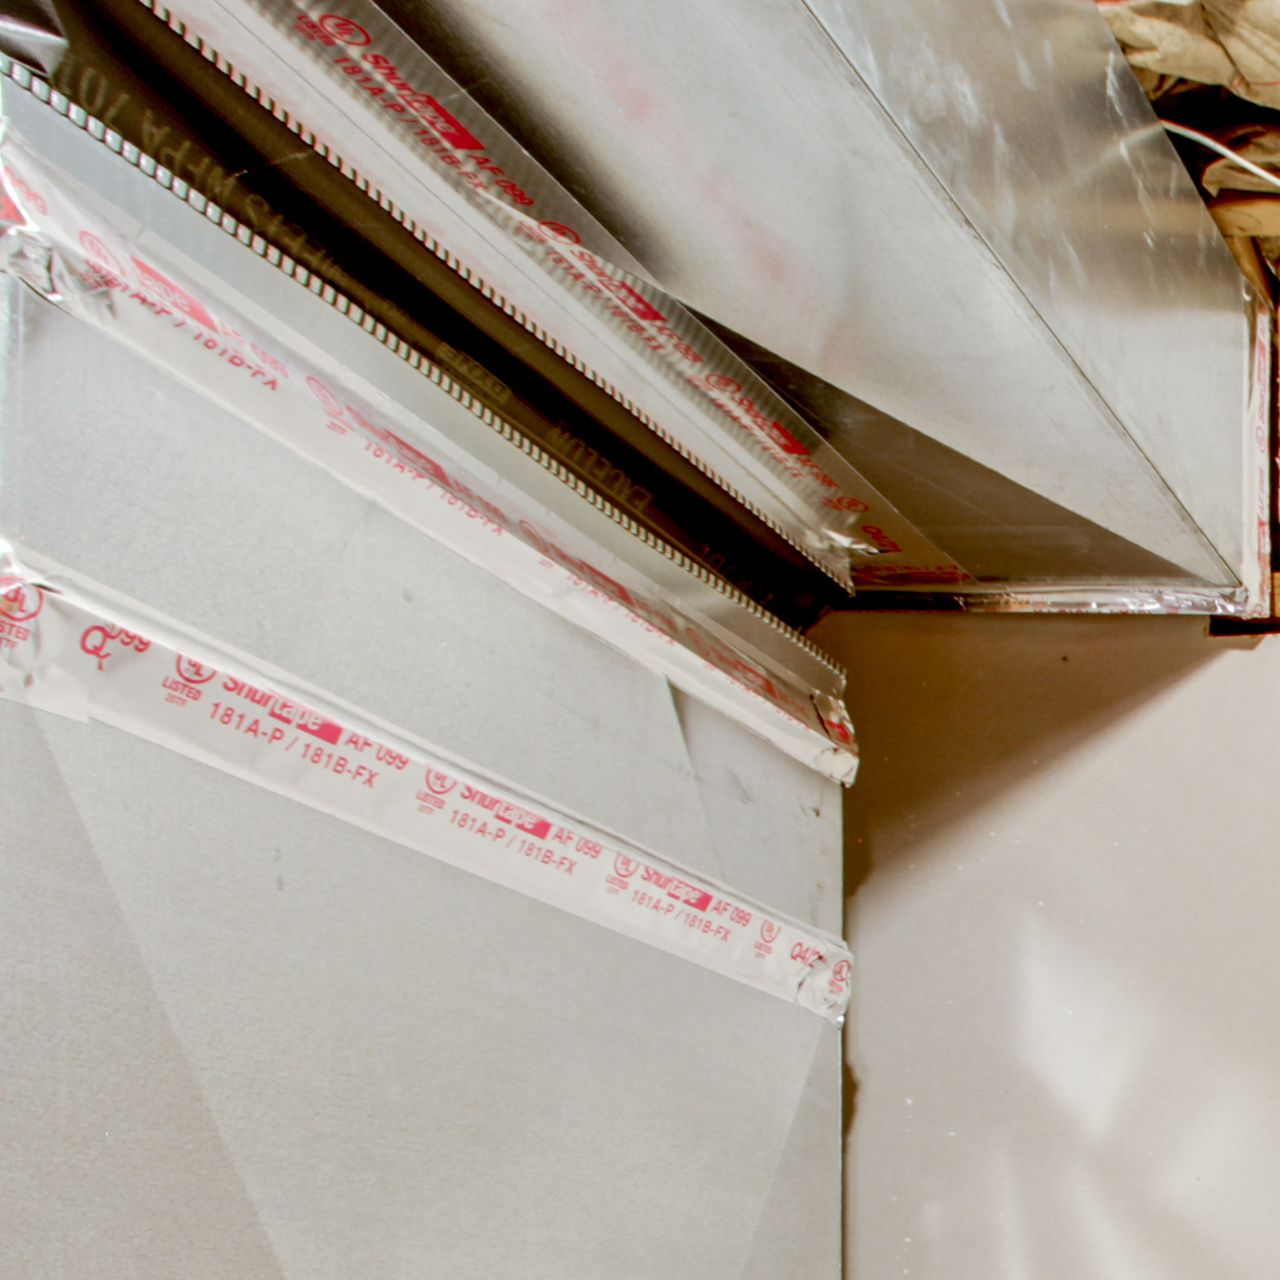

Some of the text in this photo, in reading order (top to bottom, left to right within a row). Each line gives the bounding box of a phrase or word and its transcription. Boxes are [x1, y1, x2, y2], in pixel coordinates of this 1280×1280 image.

[161, 675, 204, 702] LISTED
[209, 701, 286, 745] 181A-P
[300, 742, 380, 789] 181B-FX
[449, 808, 507, 844] 181A-P
[517, 839, 579, 876] 181B-FX
[630, 888, 676, 916] 181A-P
[683, 911, 733, 943] 181B-FX
